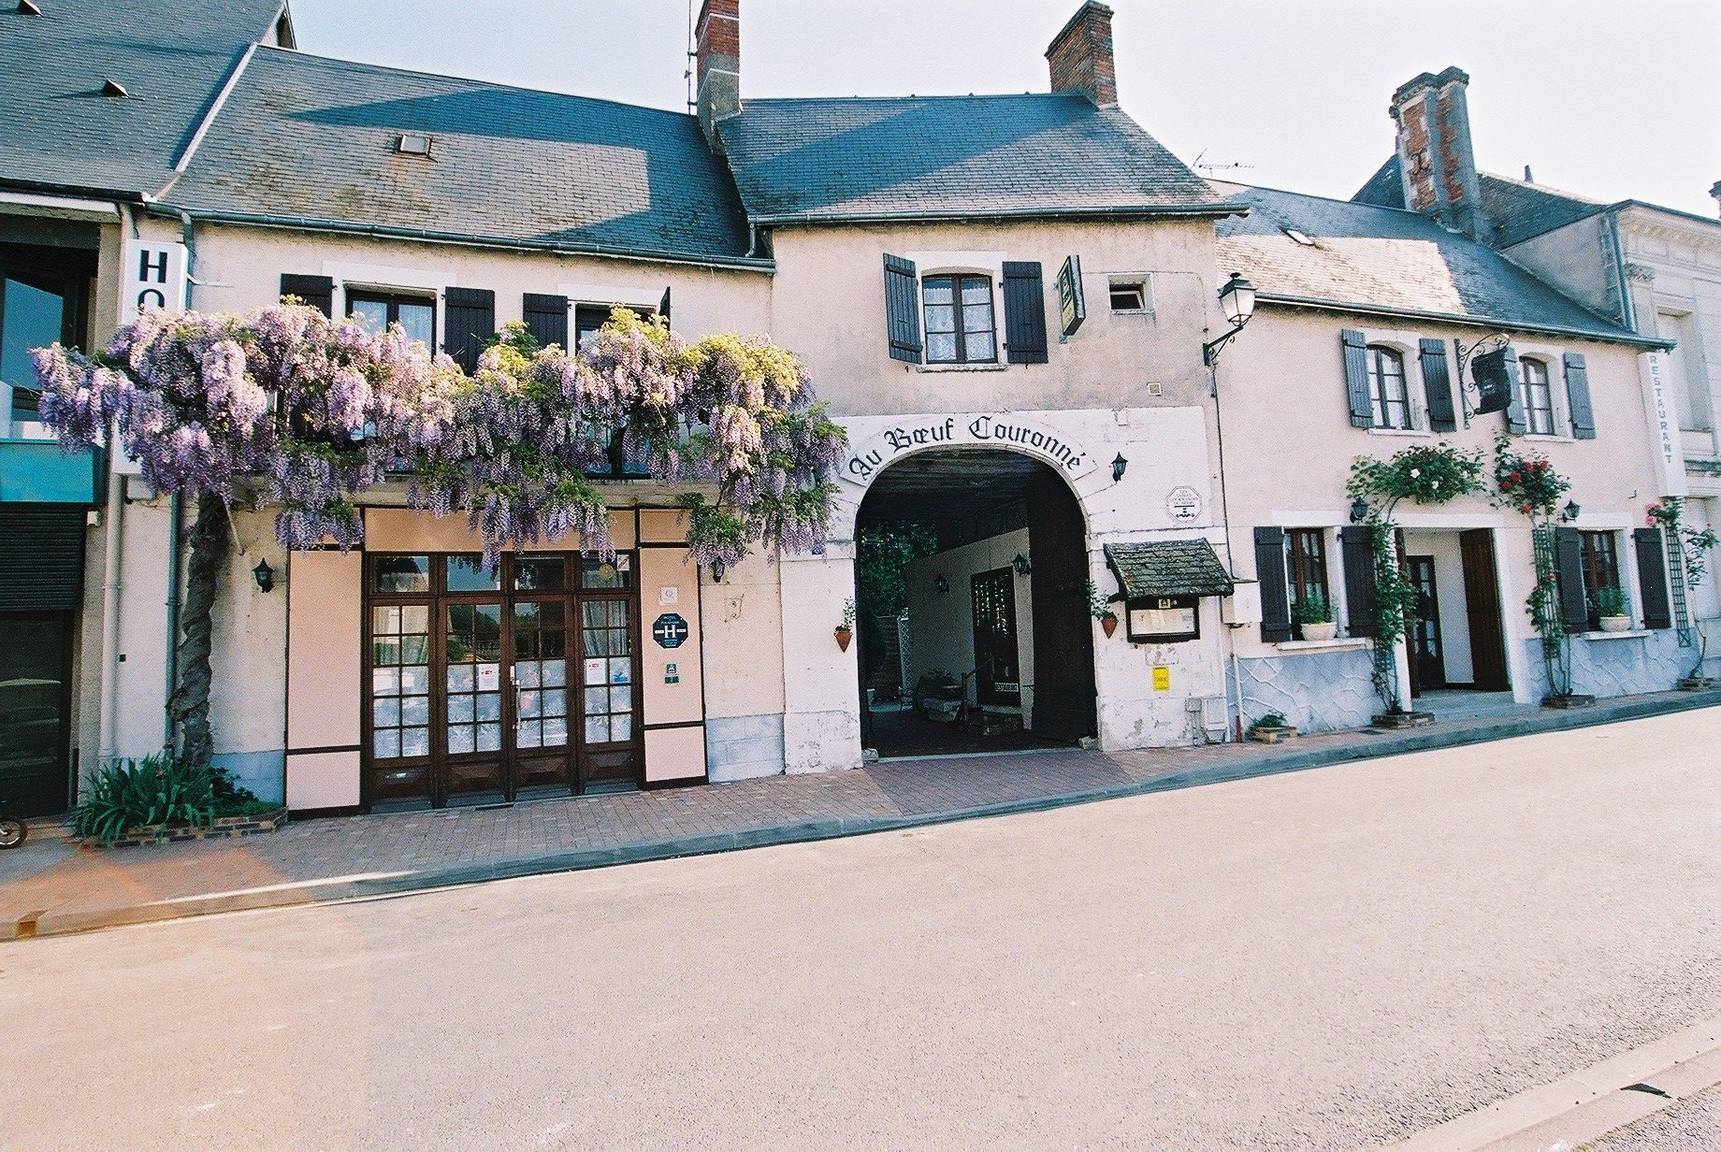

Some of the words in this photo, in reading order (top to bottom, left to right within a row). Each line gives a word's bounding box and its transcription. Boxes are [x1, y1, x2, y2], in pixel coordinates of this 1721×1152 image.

[1649, 355, 1672, 464] RESTAURANT
[848, 449, 882, 481] Au
[883, 417, 954, 453] Bœuf
[968, 415, 1087, 470] Couronné
[664, 624, 677, 639] H
